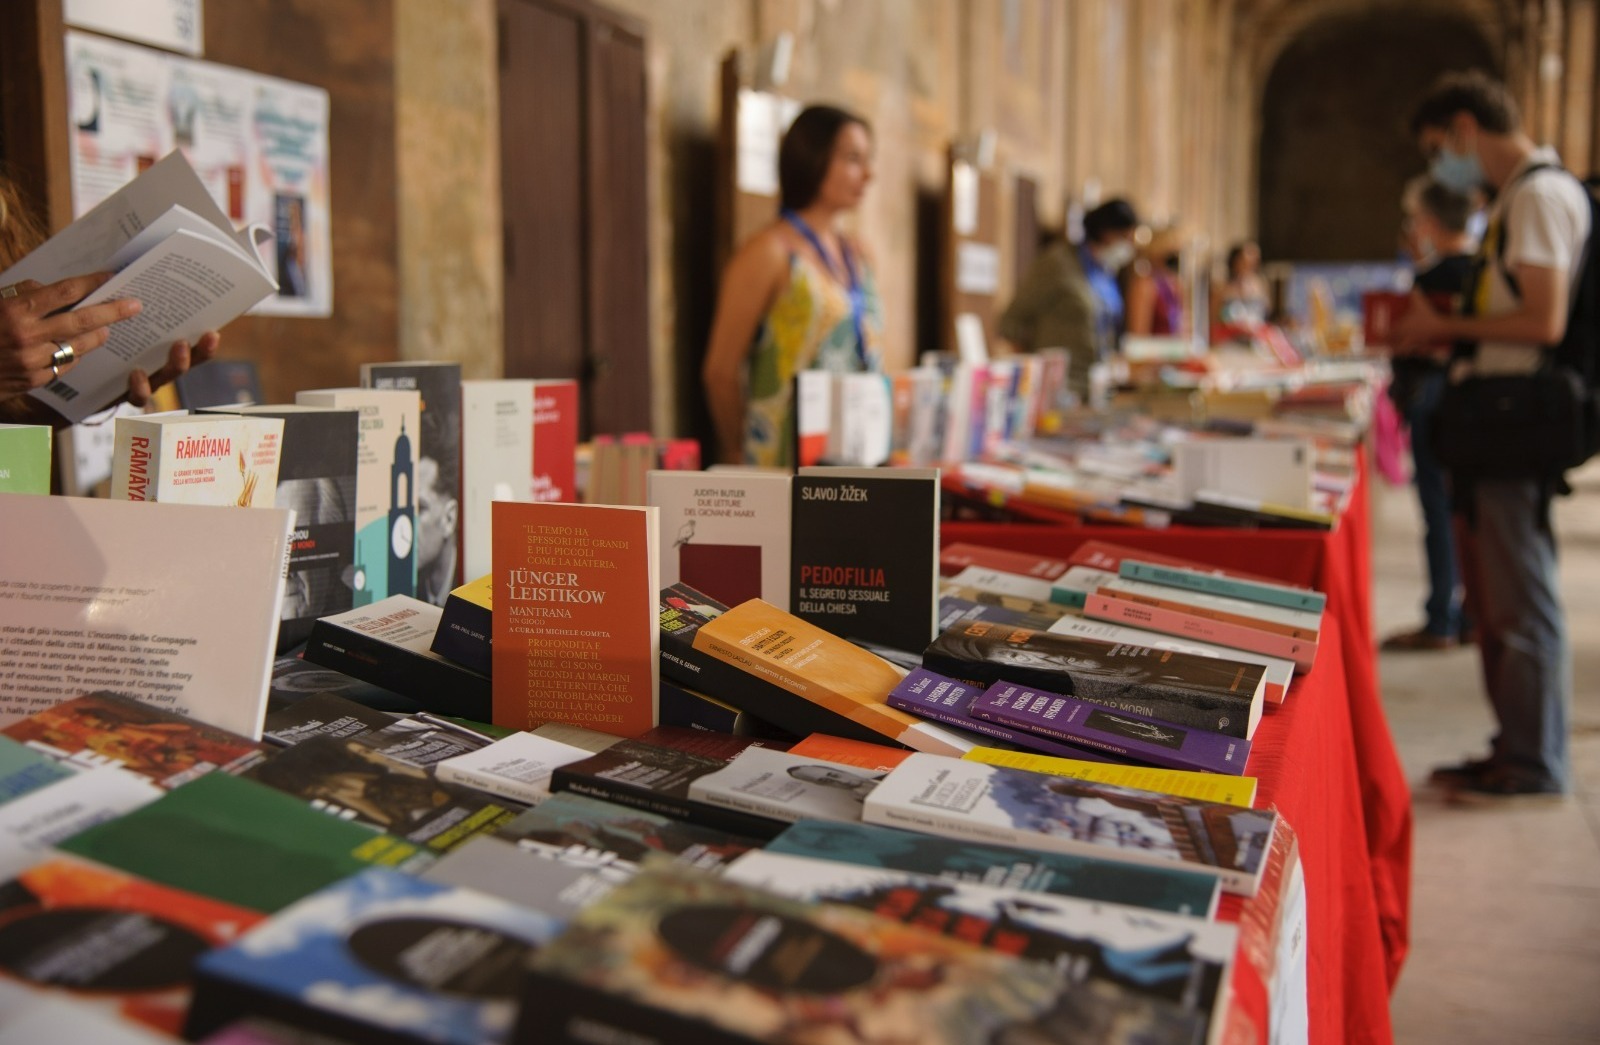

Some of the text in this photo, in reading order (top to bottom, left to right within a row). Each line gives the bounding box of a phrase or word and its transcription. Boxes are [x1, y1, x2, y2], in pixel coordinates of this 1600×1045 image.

[693, 489, 746, 498] JUDITH BUTLER
[802, 485, 868, 502] SLAVOJ ŽIŽEK
[697, 499, 741, 508] DUE LETTURE
[684, 508, 756, 518] DEL GIOVANE MARX
[537, 526, 589, 537] TEMPO HA
[527, 535, 571, 546] SPESSORI
[592, 539, 629, 550] GRANDI
[527, 545, 534, 554] E
[554, 547, 594, 557] PICCOLI
[527, 556, 558, 566] COME
[559, 557, 572, 566] LA
[507, 567, 579, 587] JÜNGER
[801, 565, 886, 588] PEDOFILIA
[510, 586, 606, 605] LEISTIKOW
[800, 588, 890, 602] IL SEGRETO SESSUALE
[509, 606, 572, 619] MANTRANA
[800, 601, 857, 615] DELLA CHIESA
[509, 617, 545, 626] UN GIOCO
[27, 626, 35, 634] di
[87, 630, 127, 640] L'incontro
[129, 633, 149, 642] delle
[151, 635, 197, 647] Compagnie
[545, 628, 579, 636] MICHELE
[580, 630, 611, 638] COMETA
[10, 638, 43, 646] cittadini
[45, 640, 65, 648] della
[86, 642, 95, 650] di
[130, 645, 141, 653] Un
[143, 647, 179, 656] racconto
[595, 641, 601, 650] E
[1, 648, 19, 656] dieci
[22, 650, 40, 658] anni
[48, 651, 76, 660] ancora
[78, 653, 96, 661] vivo
[98, 655, 118, 663] nelle
[149, 659, 170, 667] nelle
[527, 649, 600, 660] ABISSI COME IL
[40, 663, 62, 671] teatri
[64, 664, 84, 672] delle
[86, 666, 121, 677] periferie
[129, 668, 145, 677] This
[156, 670, 169, 679] the
[171, 672, 193, 682] story
[560, 660, 571, 669] CI
[573, 661, 602, 671] SONO
[684, 661, 701, 674] GENERE
[709, 643, 733, 658] ERNESTO
[732, 655, 752, 667] LACLAU
[755, 664, 779, 679] DIBATTITI
[784, 676, 807, 692] SCONTRI
[5, 671, 14, 679] of
[66, 675, 81, 683] The
[83, 677, 124, 686] encounter
[126, 679, 136, 688] of
[137, 680, 184, 692] Compagnie
[528, 669, 630, 683] SECONDI AI MARGINI
[1, 683, 14, 691] the
[16, 684, 62, 694] inhabitants
[64, 687, 74, 695] of
[155, 694, 176, 704] story
[606, 683, 628, 693] CHE
[528, 689, 633, 703] CONTROBILANCIANO
[6, 707, 25, 715] halls
[30, 697, 52, 706] years
[175, 707, 189, 715] the
[1120, 703, 1153, 717] MORIN
[527, 710, 624, 723] ANCORA ACCADERE
[978, 725, 1013, 739] SOPRATTUTTO
[1031, 725, 1061, 739] FOTOGRAFIA
[1067, 734, 1091, 747] PENSIERO
[1091, 740, 1127, 754] FOTOGRAFICO
